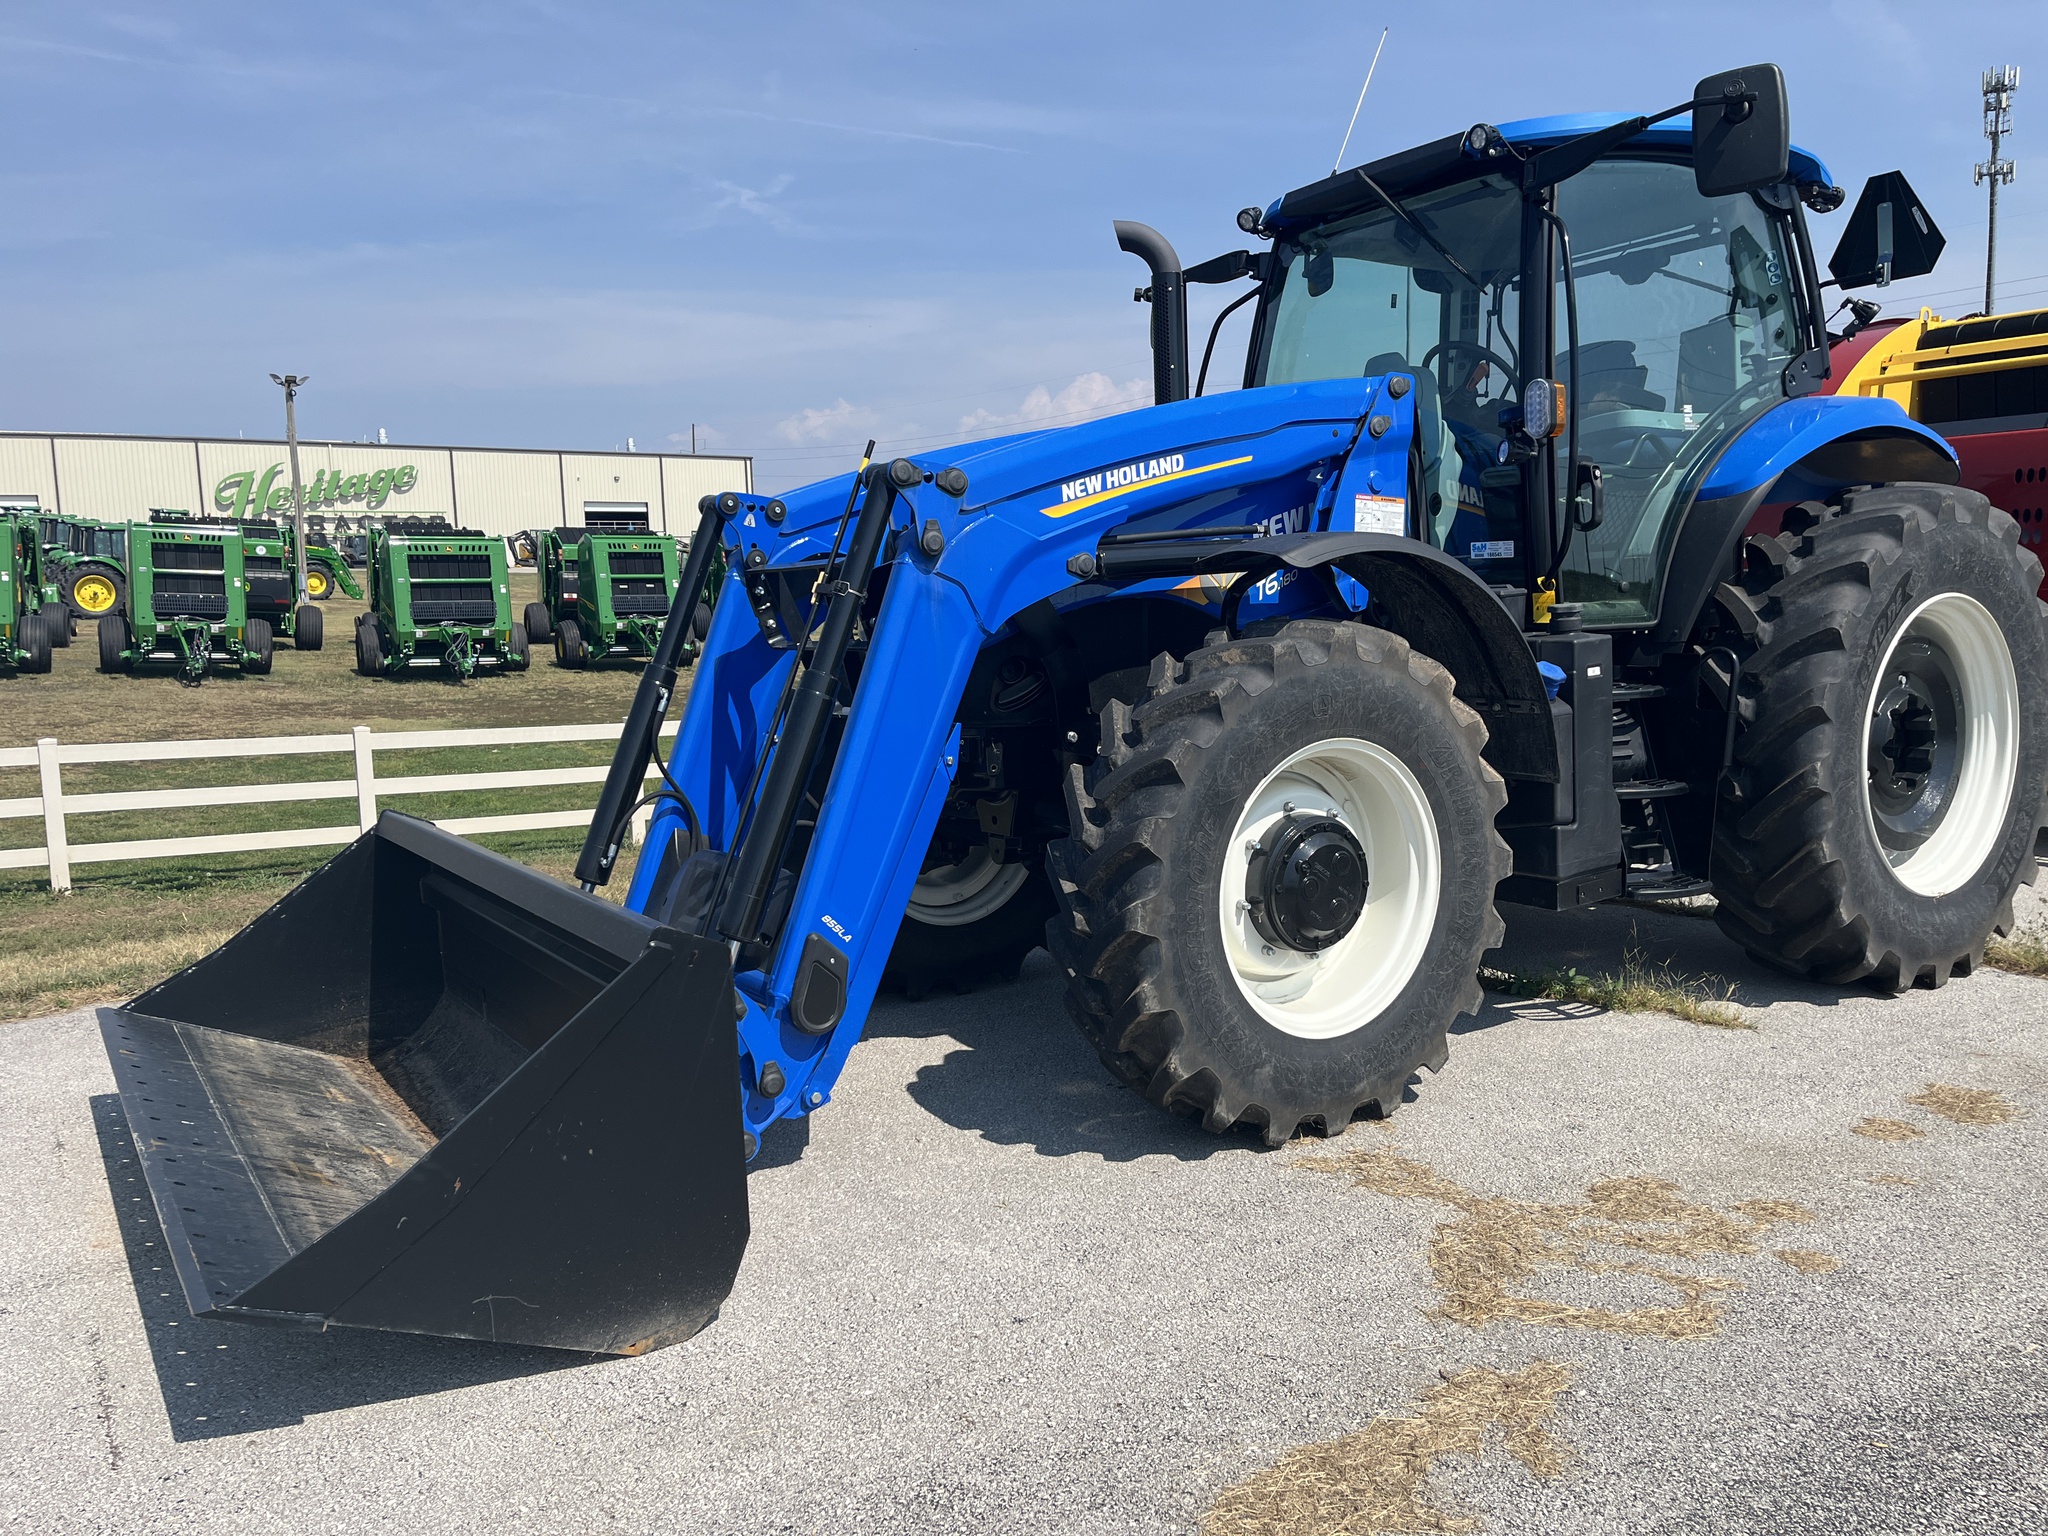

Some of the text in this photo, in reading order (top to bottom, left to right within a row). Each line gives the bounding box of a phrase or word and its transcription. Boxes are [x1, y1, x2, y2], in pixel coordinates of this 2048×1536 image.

[214, 461, 420, 519] Heritage
[1061, 453, 1185, 503] NEW HOLLAND
[1255, 568, 1299, 602] T6.180
[821, 914, 853, 943] 855LA
